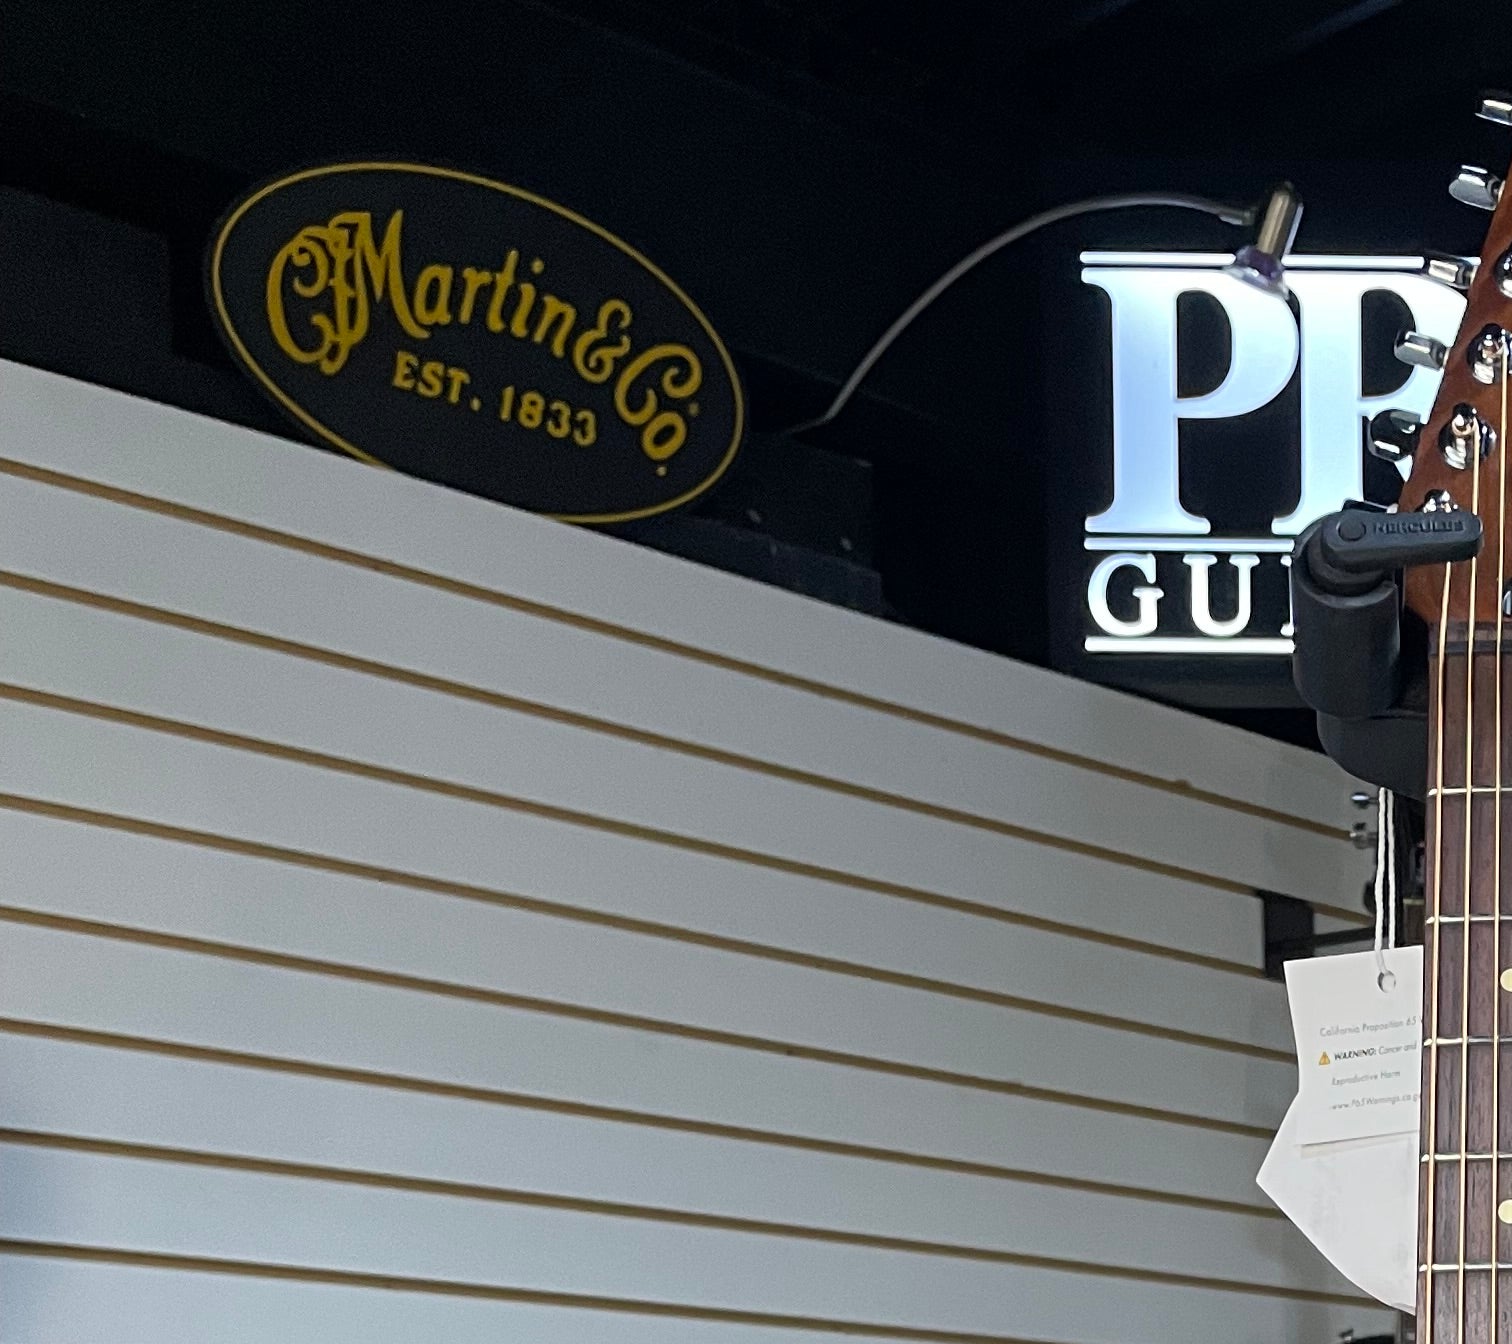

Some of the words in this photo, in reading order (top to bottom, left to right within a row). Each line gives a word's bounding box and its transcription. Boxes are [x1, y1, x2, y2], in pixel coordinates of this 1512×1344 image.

[393, 351, 480, 411] EST.
[500, 386, 598, 447] 1833
[1373, 520, 1465, 535] HERCULES
[1087, 552, 1295, 637] GU
[1320, 1023, 1360, 1038] California
[1362, 1018, 1404, 1034] Proposition
[1406, 1015, 1417, 1026] 65
[1334, 1047, 1378, 1061] WARNING:
[1378, 1044, 1402, 1056] Cancer
[1403, 1041, 1418, 1052] and
[1331, 1072, 1379, 1086] Reproductive
[1380, 1070, 1401, 1080] Harm
